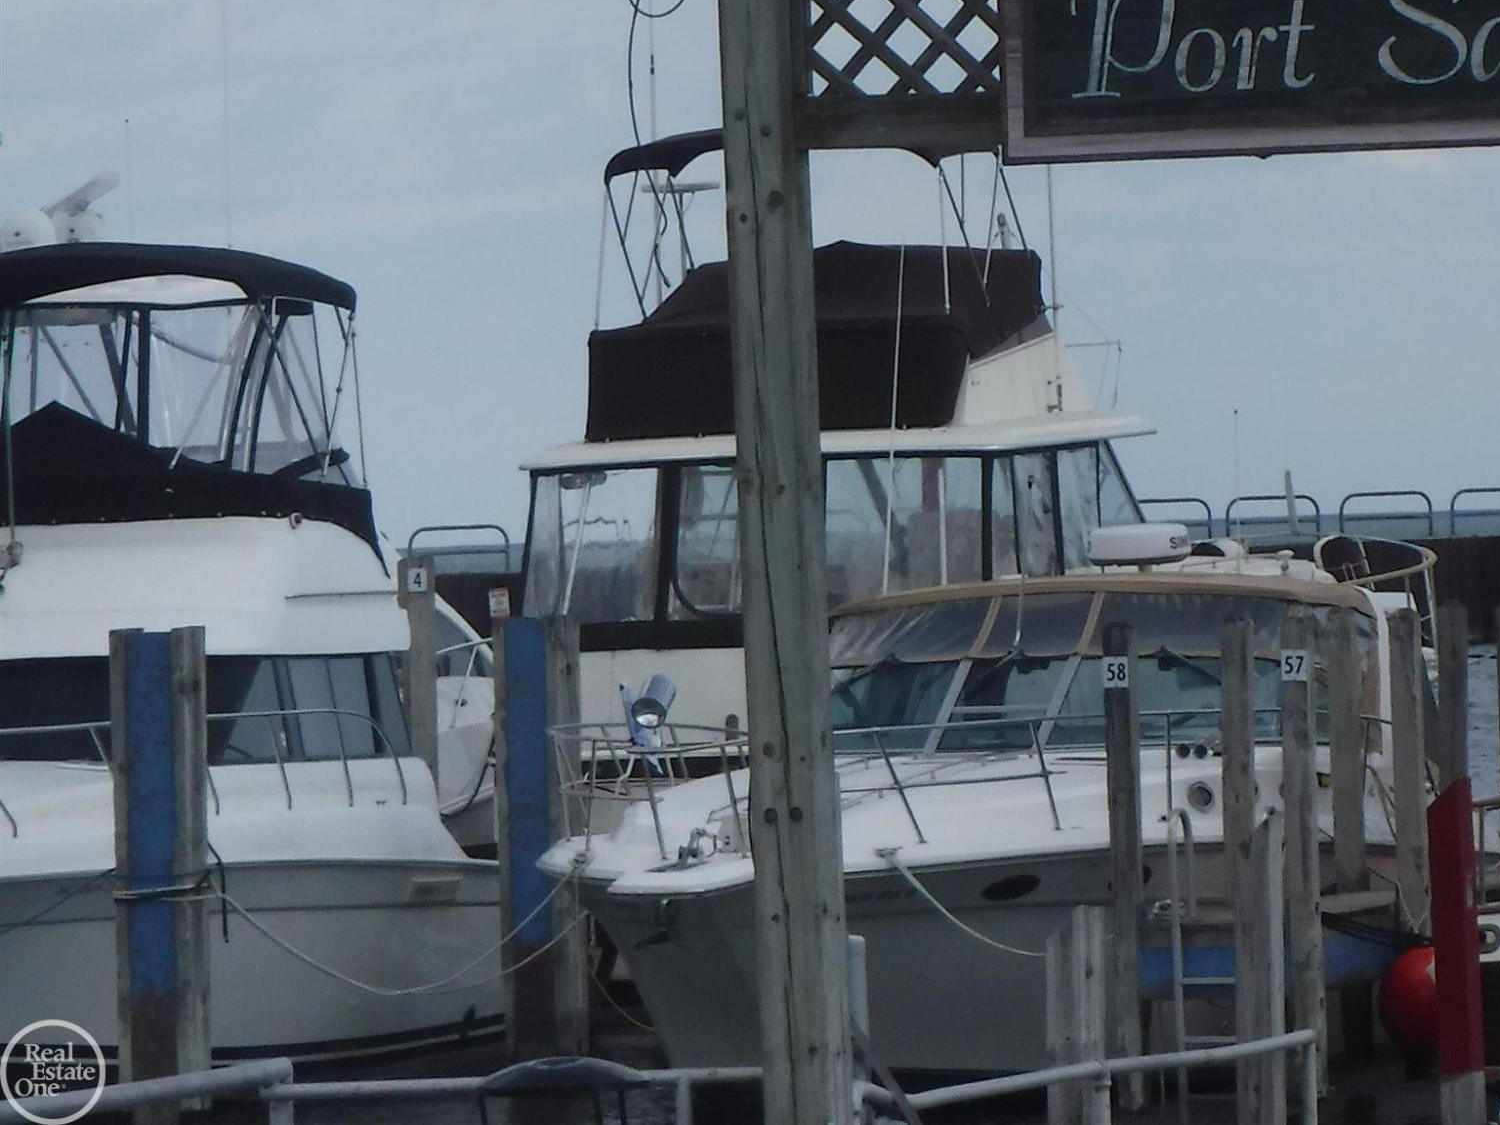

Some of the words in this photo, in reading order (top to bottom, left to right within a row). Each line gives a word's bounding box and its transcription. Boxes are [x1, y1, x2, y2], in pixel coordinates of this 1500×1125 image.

[413, 572, 422, 588] 4
[1106, 662, 1126, 682] 58
[1284, 655, 1304, 674] 57
